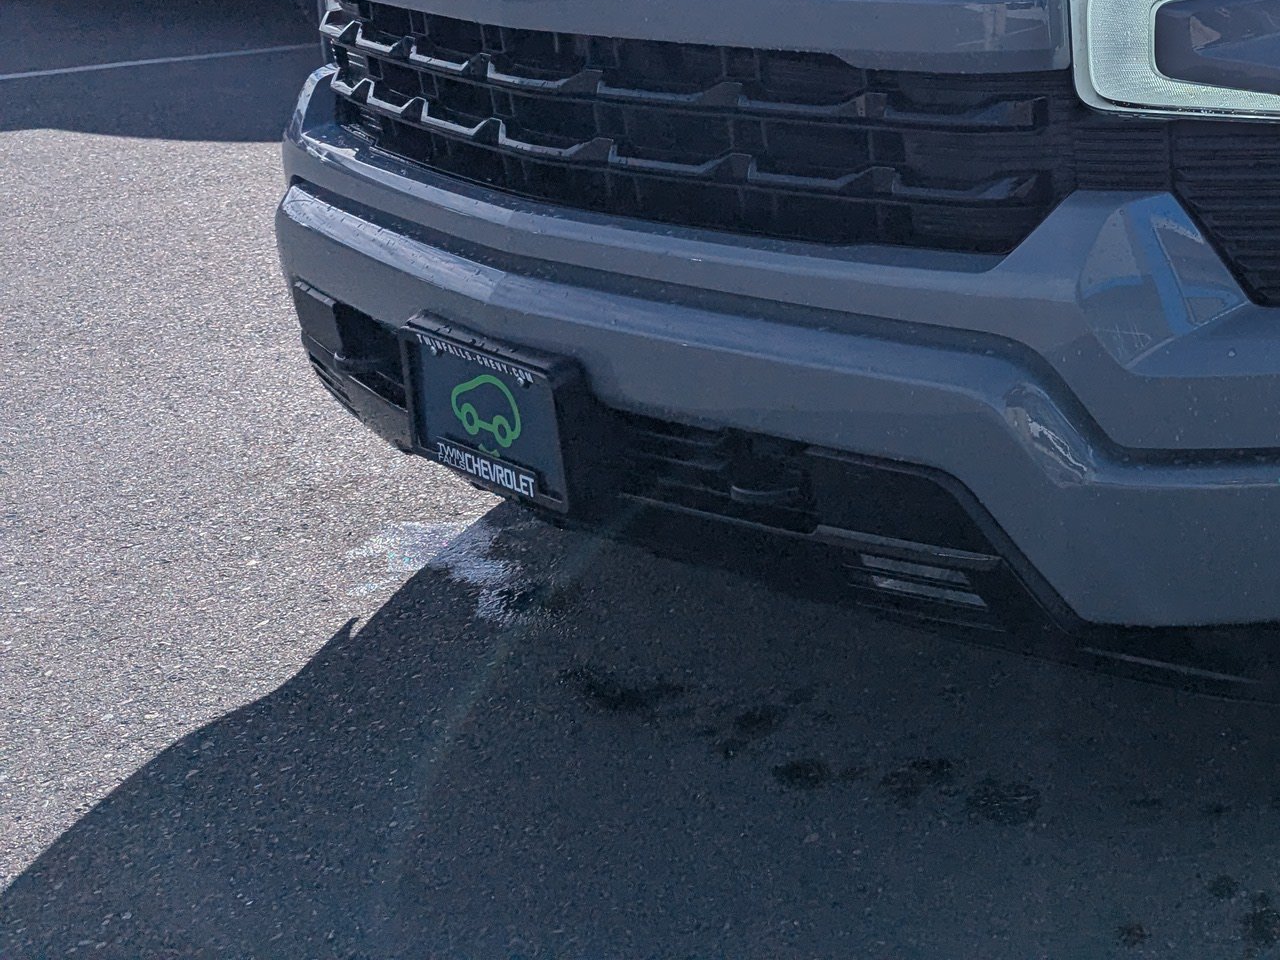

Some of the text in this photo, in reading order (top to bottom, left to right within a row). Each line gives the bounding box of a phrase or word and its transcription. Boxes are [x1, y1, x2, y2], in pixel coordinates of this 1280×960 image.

[416, 334, 534, 384] TWINFALLS-CHEVY.COM
[437, 442, 466, 462] TWIN
[437, 452, 466, 471] FALLS
[464, 452, 535, 498] CHEVROLET
